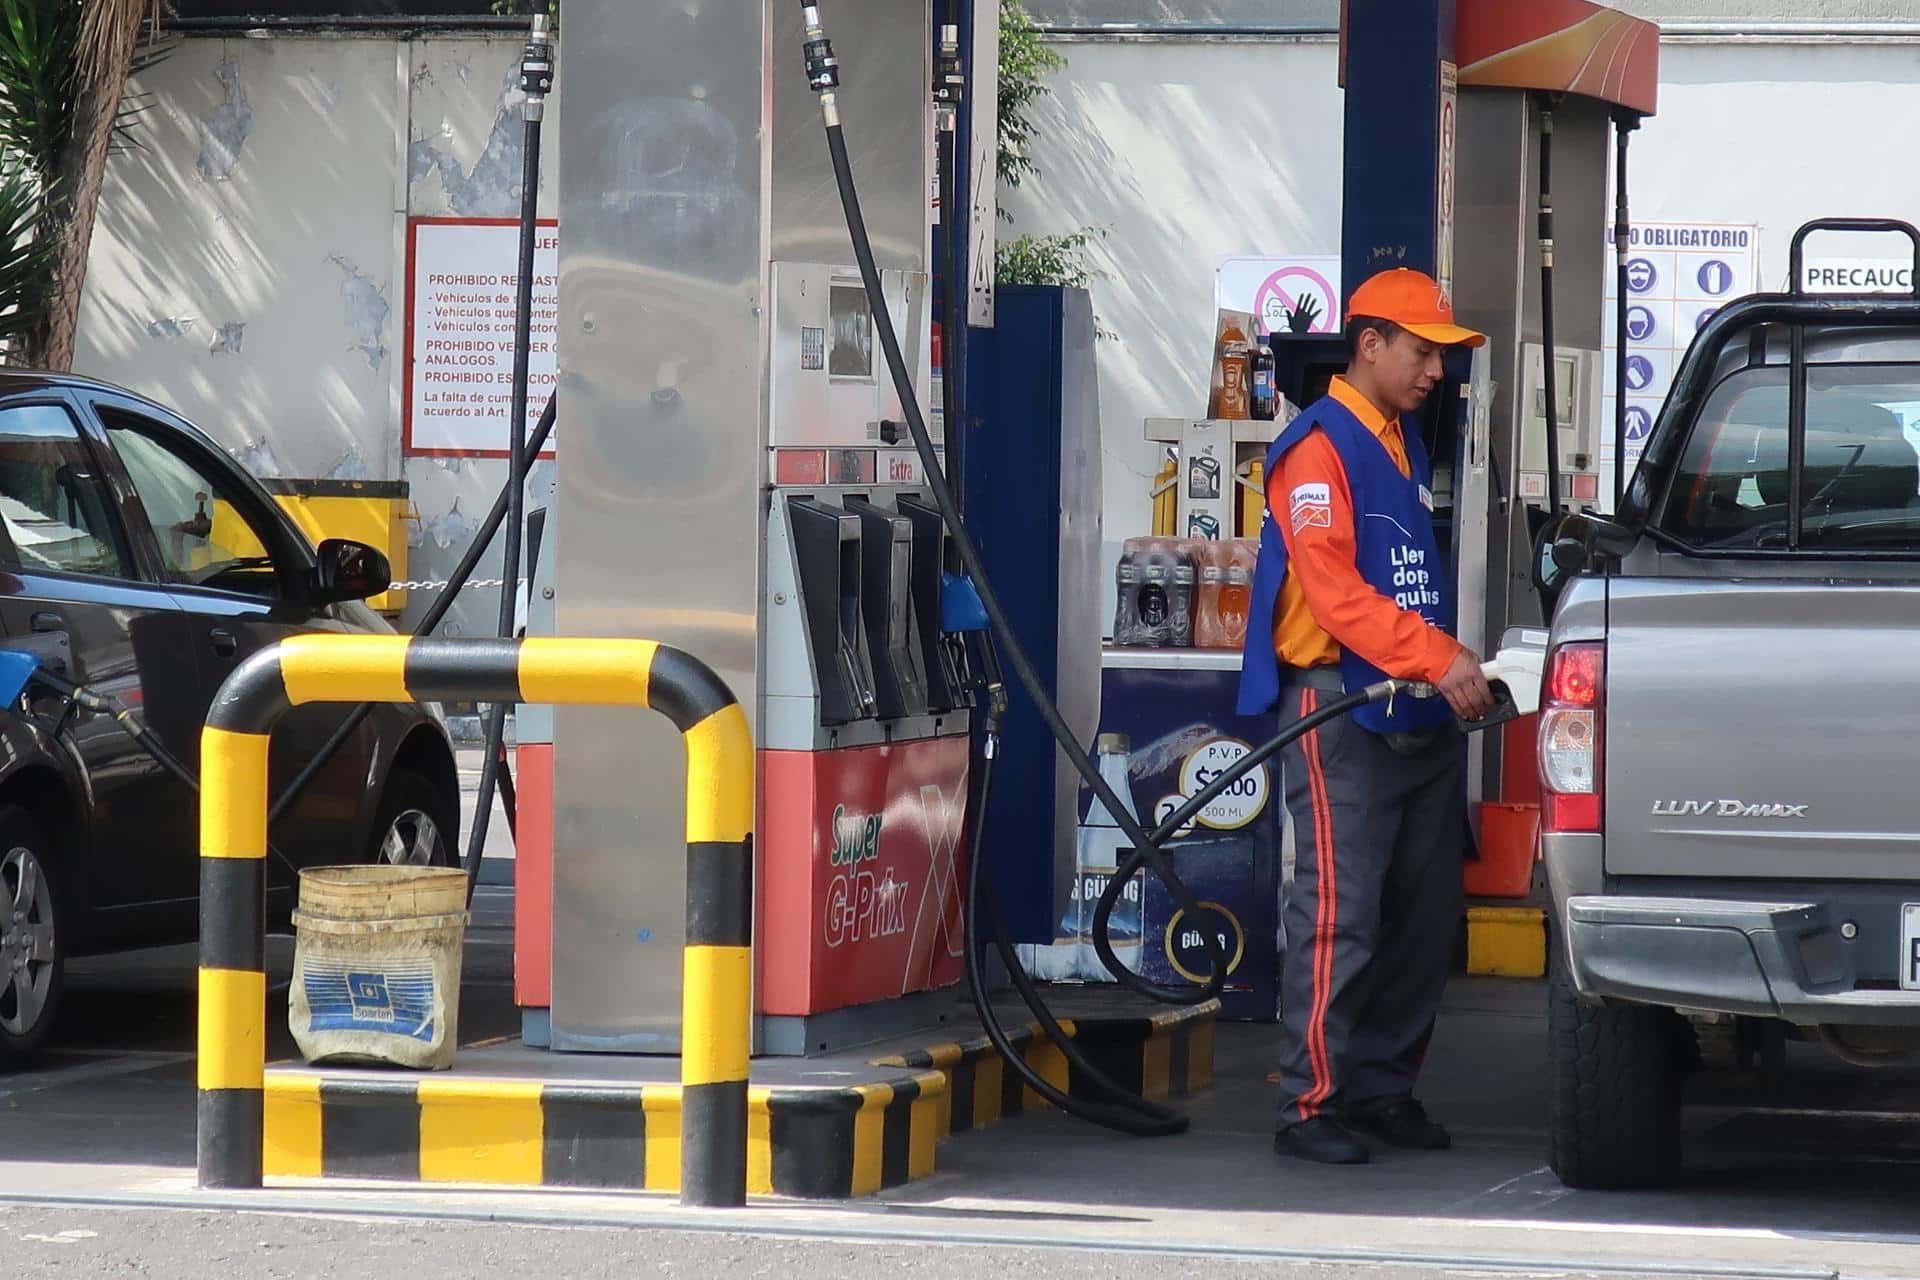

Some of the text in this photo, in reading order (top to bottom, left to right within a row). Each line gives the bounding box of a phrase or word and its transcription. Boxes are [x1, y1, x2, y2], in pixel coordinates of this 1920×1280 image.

[1608, 228, 1748, 247] UO OBLIGATORIO
[428, 274, 498, 286] PROHIBIDO
[1807, 268, 1915, 288] PRECAUC
[495, 293, 510, 304] de
[494, 309, 517, 320] que
[494, 323, 516, 332] con
[426, 340, 495, 352] PROHIBIDO
[425, 371, 494, 383] PROHIBIDO
[424, 391, 438, 402] La
[442, 391, 466, 402] falta
[470, 392, 484, 403] de
[424, 407, 471, 417] acuerdo
[474, 407, 484, 417] al
[889, 456, 912, 481] Extra
[1204, 807, 1226, 817] 500
[1651, 799, 1715, 816] LUV
[831, 803, 885, 879] Super
[825, 866, 909, 948] G-Prix
